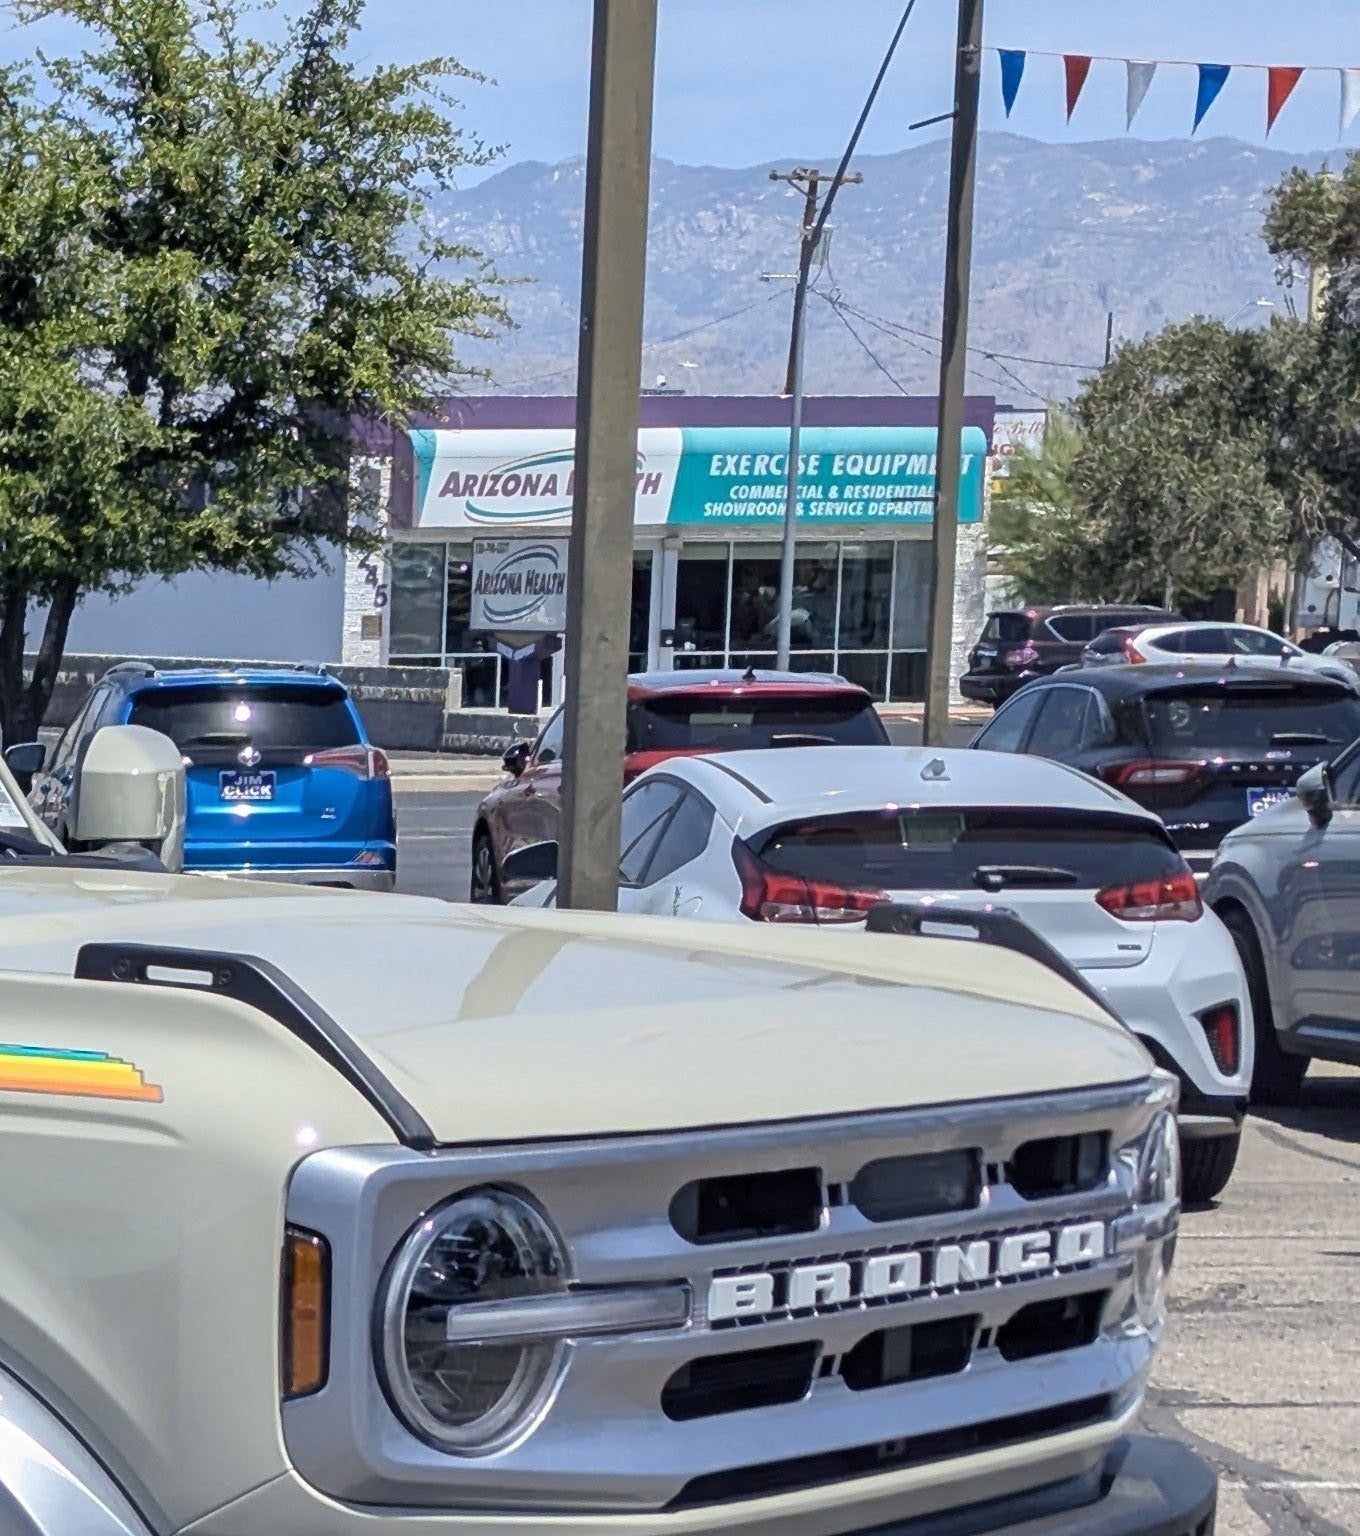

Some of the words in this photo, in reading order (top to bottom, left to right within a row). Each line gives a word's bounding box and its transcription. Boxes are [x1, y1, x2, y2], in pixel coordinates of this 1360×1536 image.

[832, 454, 973, 476] EQUIPMT
[438, 471, 558, 497] ARIZONA
[828, 485, 838, 499] &
[843, 485, 935, 499] RESIDENTIAL
[809, 502, 865, 516] SERVICE
[868, 502, 934, 516] DEPARTM
[474, 570, 522, 595] ARIZONA
[524, 570, 565, 595] HEALTH
[234, 775, 262, 785] JIM
[223, 785, 272, 796] CLICK
[707, 1220, 1106, 1322] BRONCO
